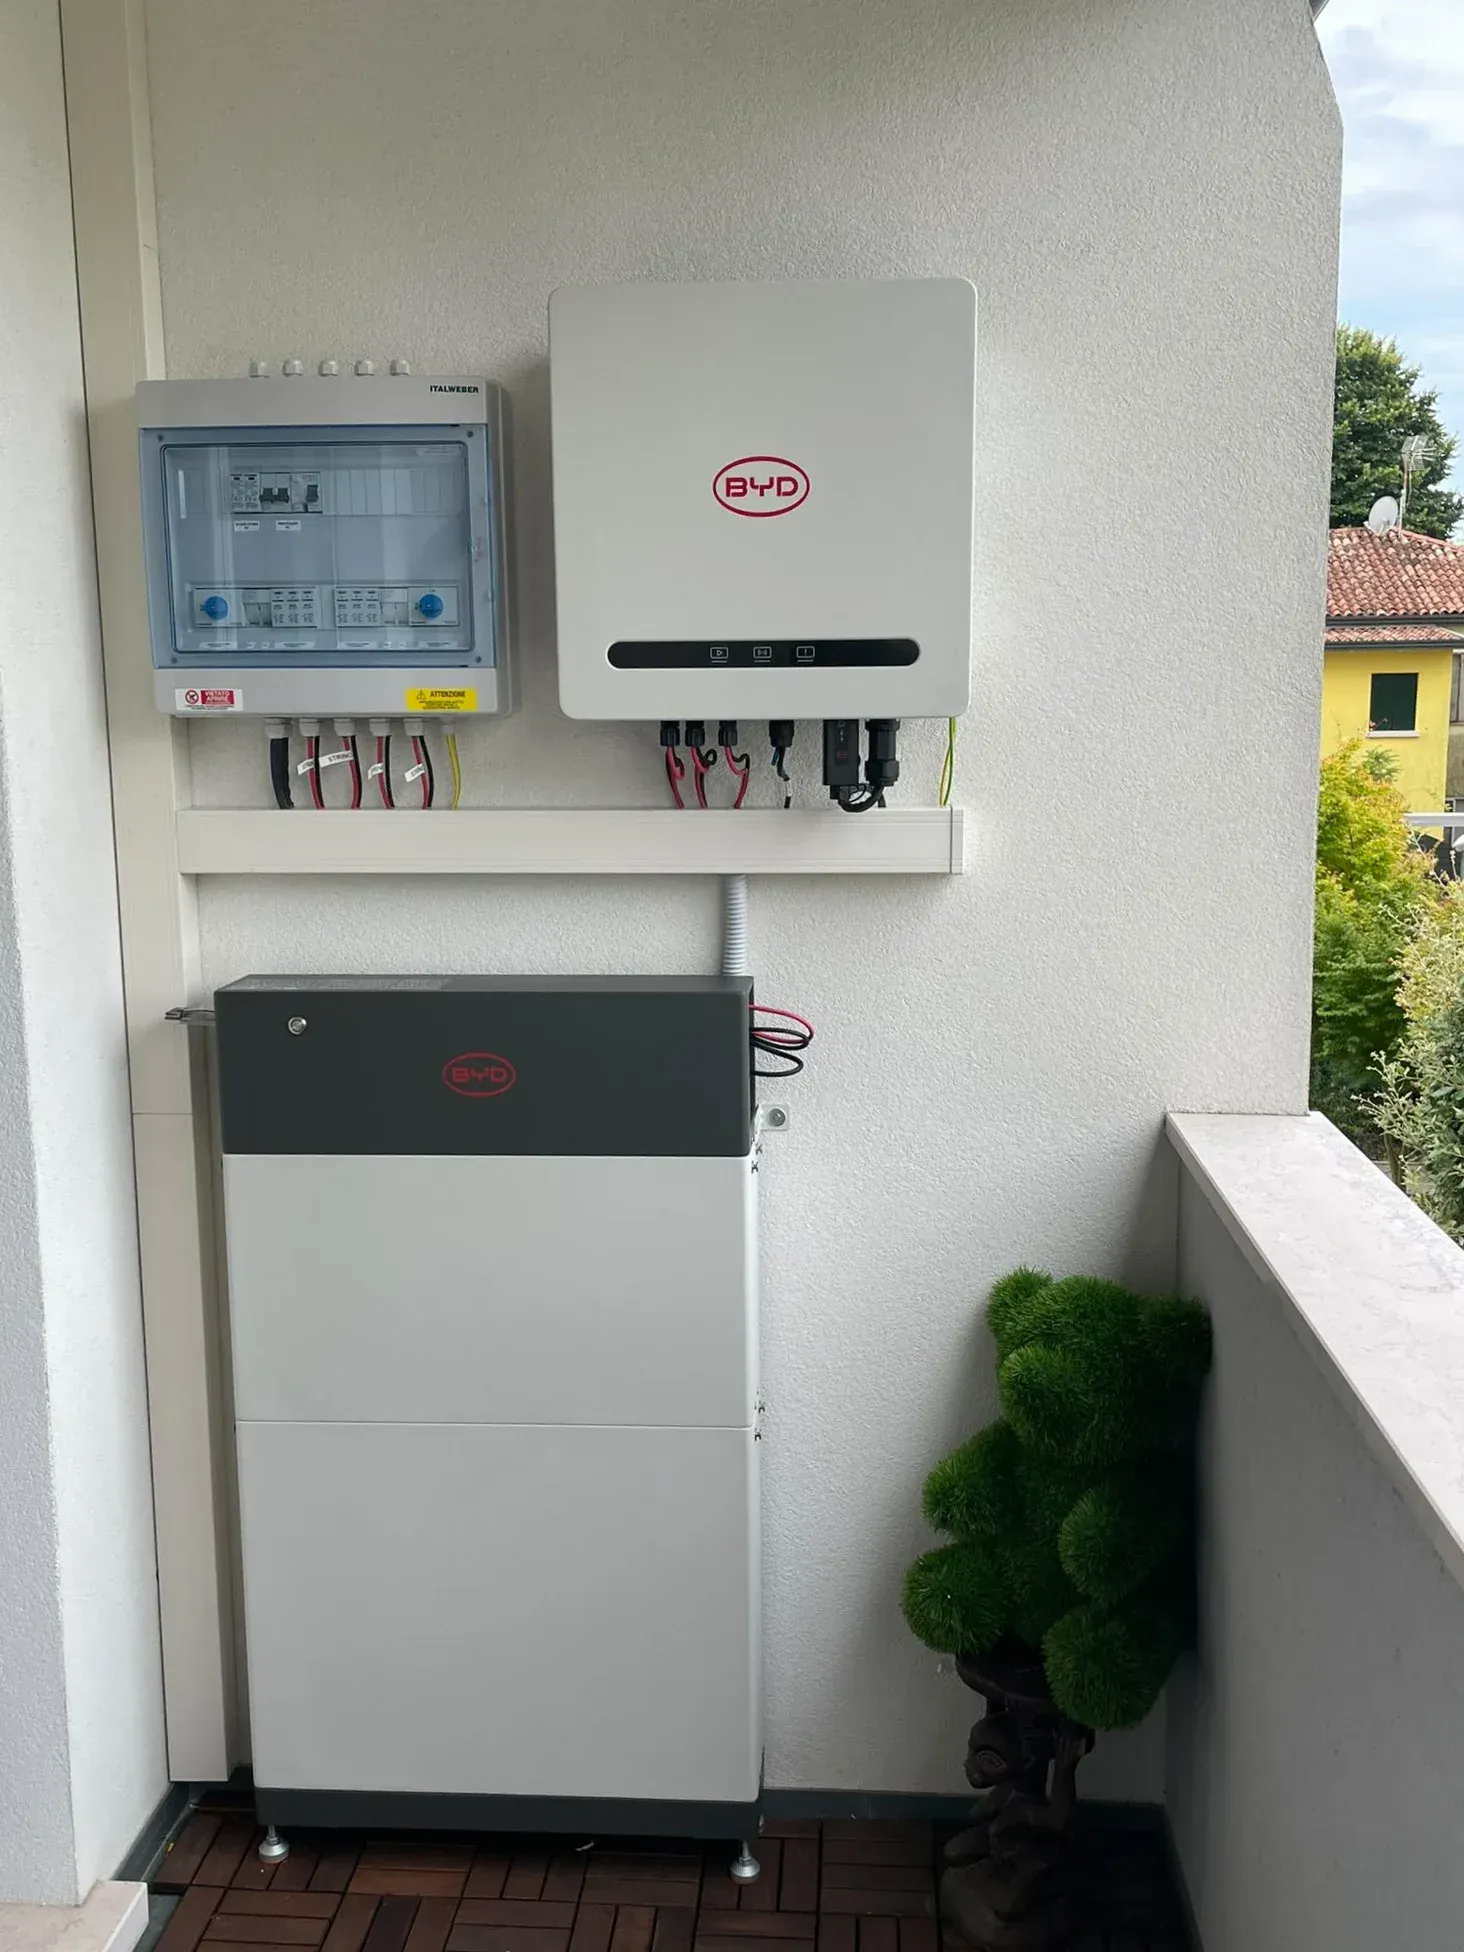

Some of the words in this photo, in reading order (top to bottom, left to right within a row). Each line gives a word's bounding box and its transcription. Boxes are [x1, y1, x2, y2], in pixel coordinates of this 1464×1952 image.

[430, 385, 479, 393] ITALWEBER
[725, 476, 799, 498] BYD
[452, 1066, 507, 1083] BYD
